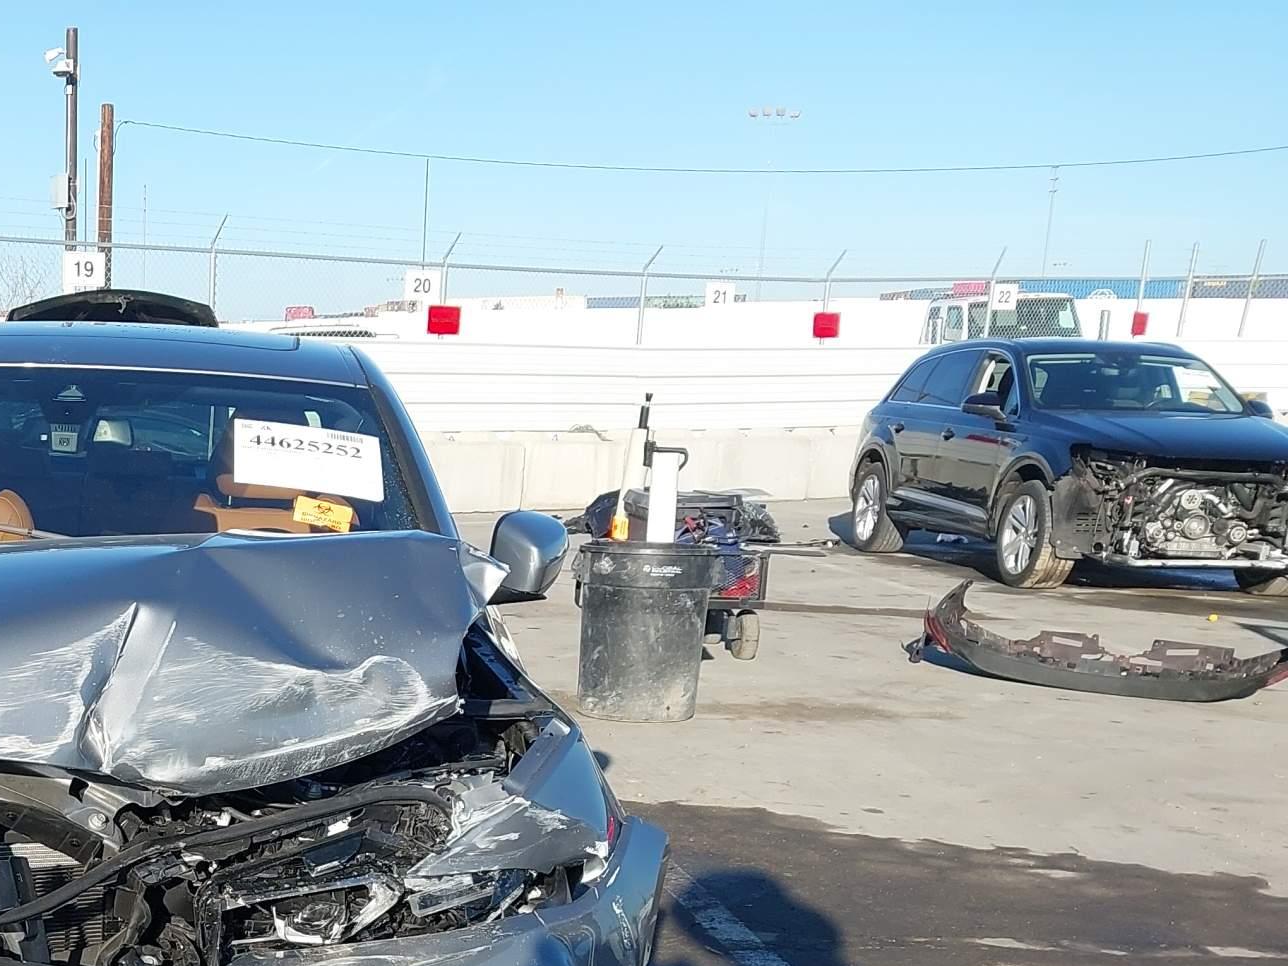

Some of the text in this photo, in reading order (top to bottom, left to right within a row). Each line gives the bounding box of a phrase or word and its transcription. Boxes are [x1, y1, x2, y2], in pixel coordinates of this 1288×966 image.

[73, 260, 94, 278] 19
[413, 277, 431, 294] 20
[712, 289, 728, 305] 21
[996, 290, 1011, 304] 22
[249, 434, 363, 459] 44625252
